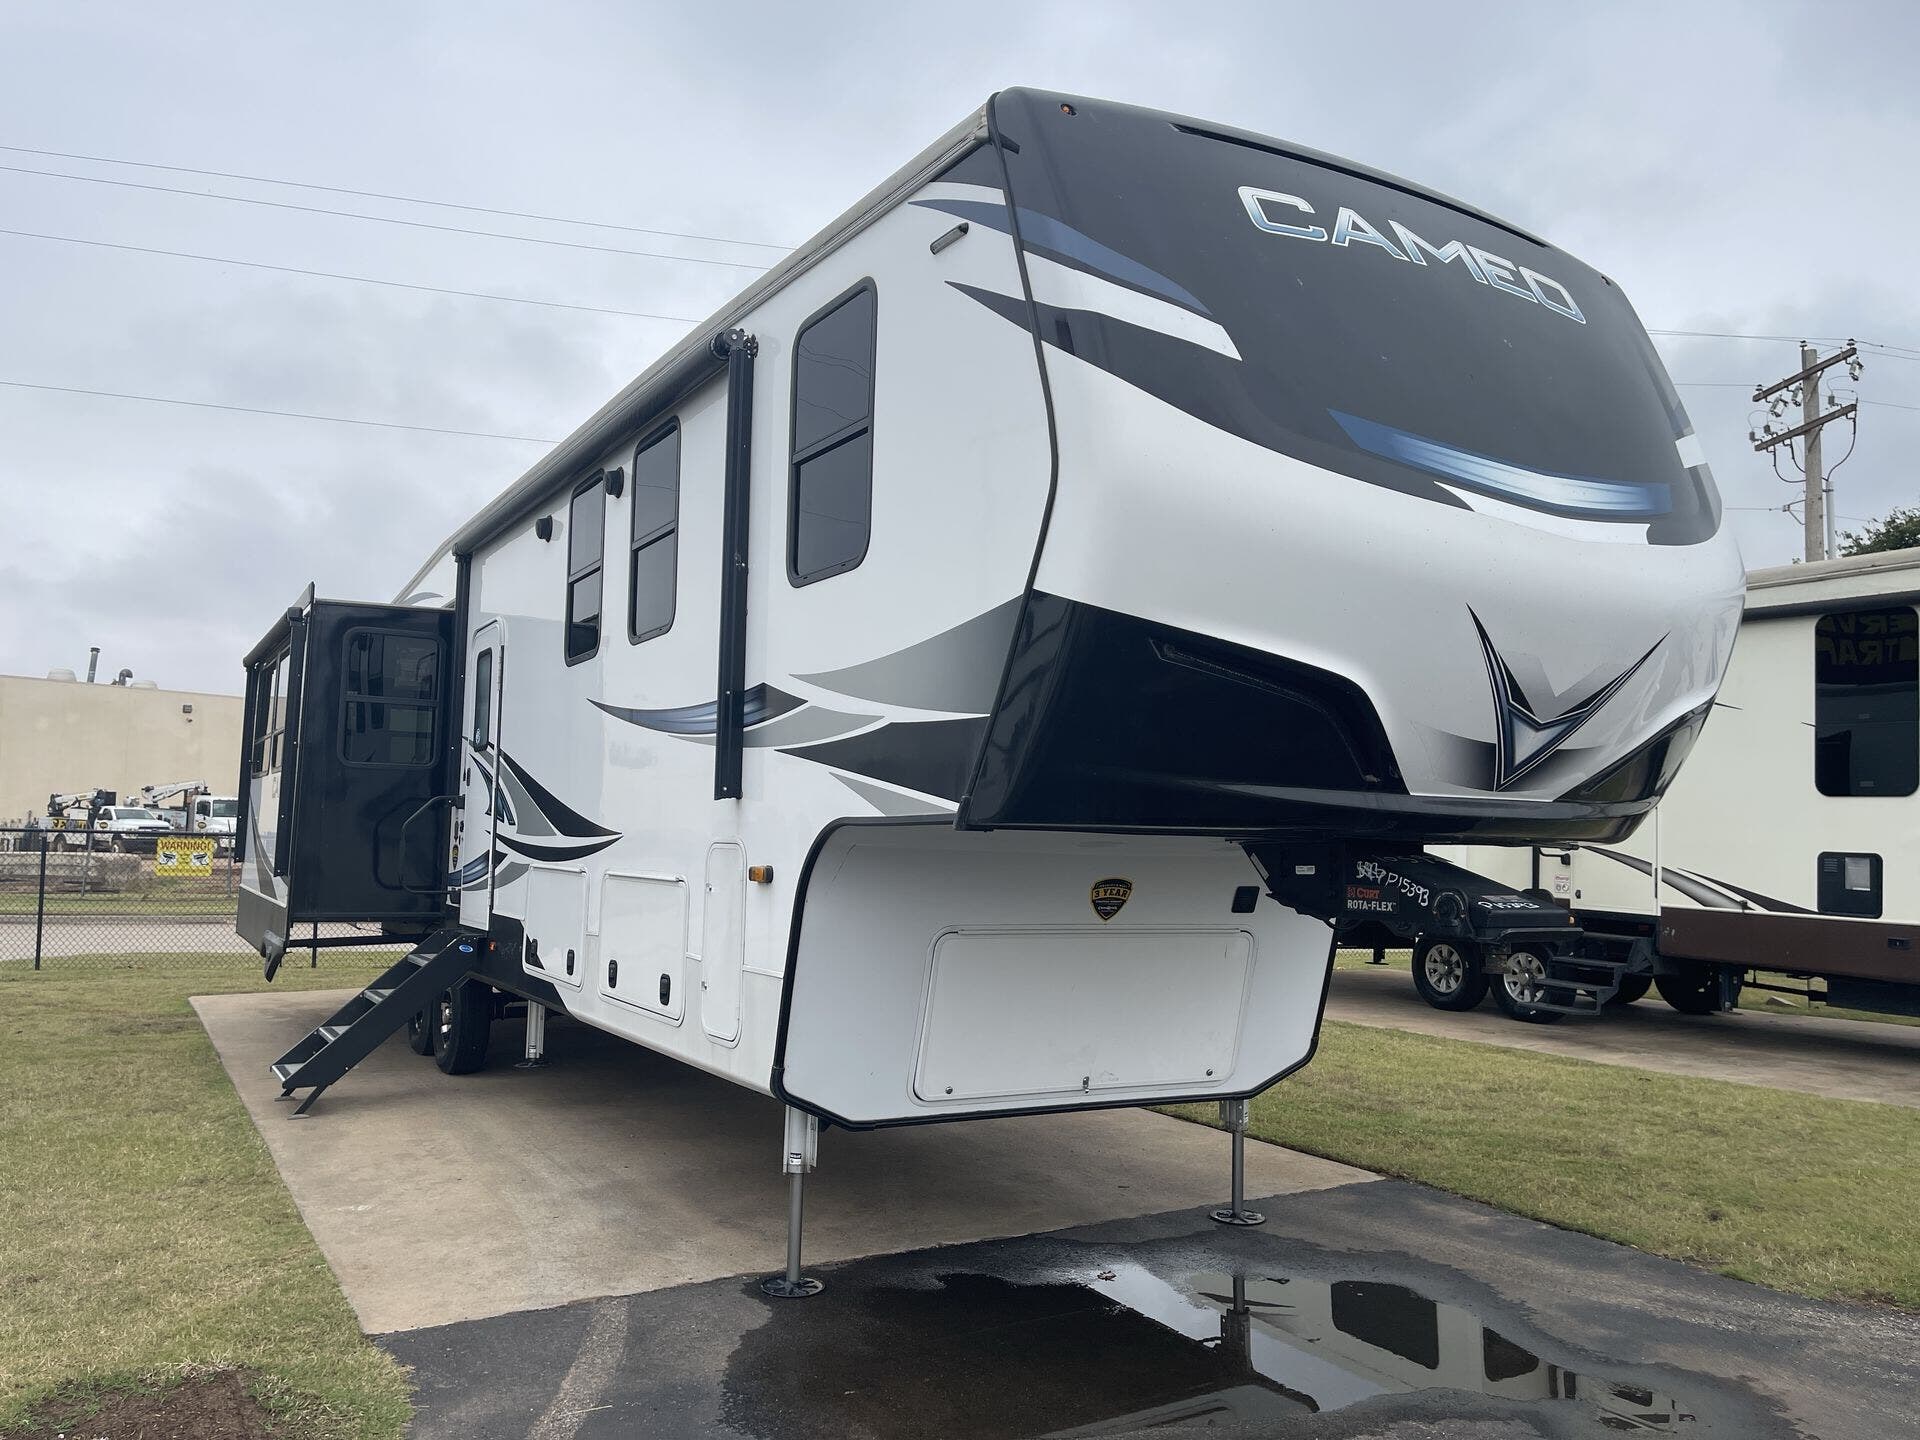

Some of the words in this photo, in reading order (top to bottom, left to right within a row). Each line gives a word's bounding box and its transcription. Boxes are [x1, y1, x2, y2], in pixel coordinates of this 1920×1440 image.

[1238, 186, 1587, 325] CAMEO
[161, 841, 210, 851] WARNING!
[1103, 889, 1128, 898] YEAR
[1356, 887, 1380, 899] CURT
[1385, 872, 1430, 907] P15393
[1347, 899, 1393, 912] ROTA-FLEX
